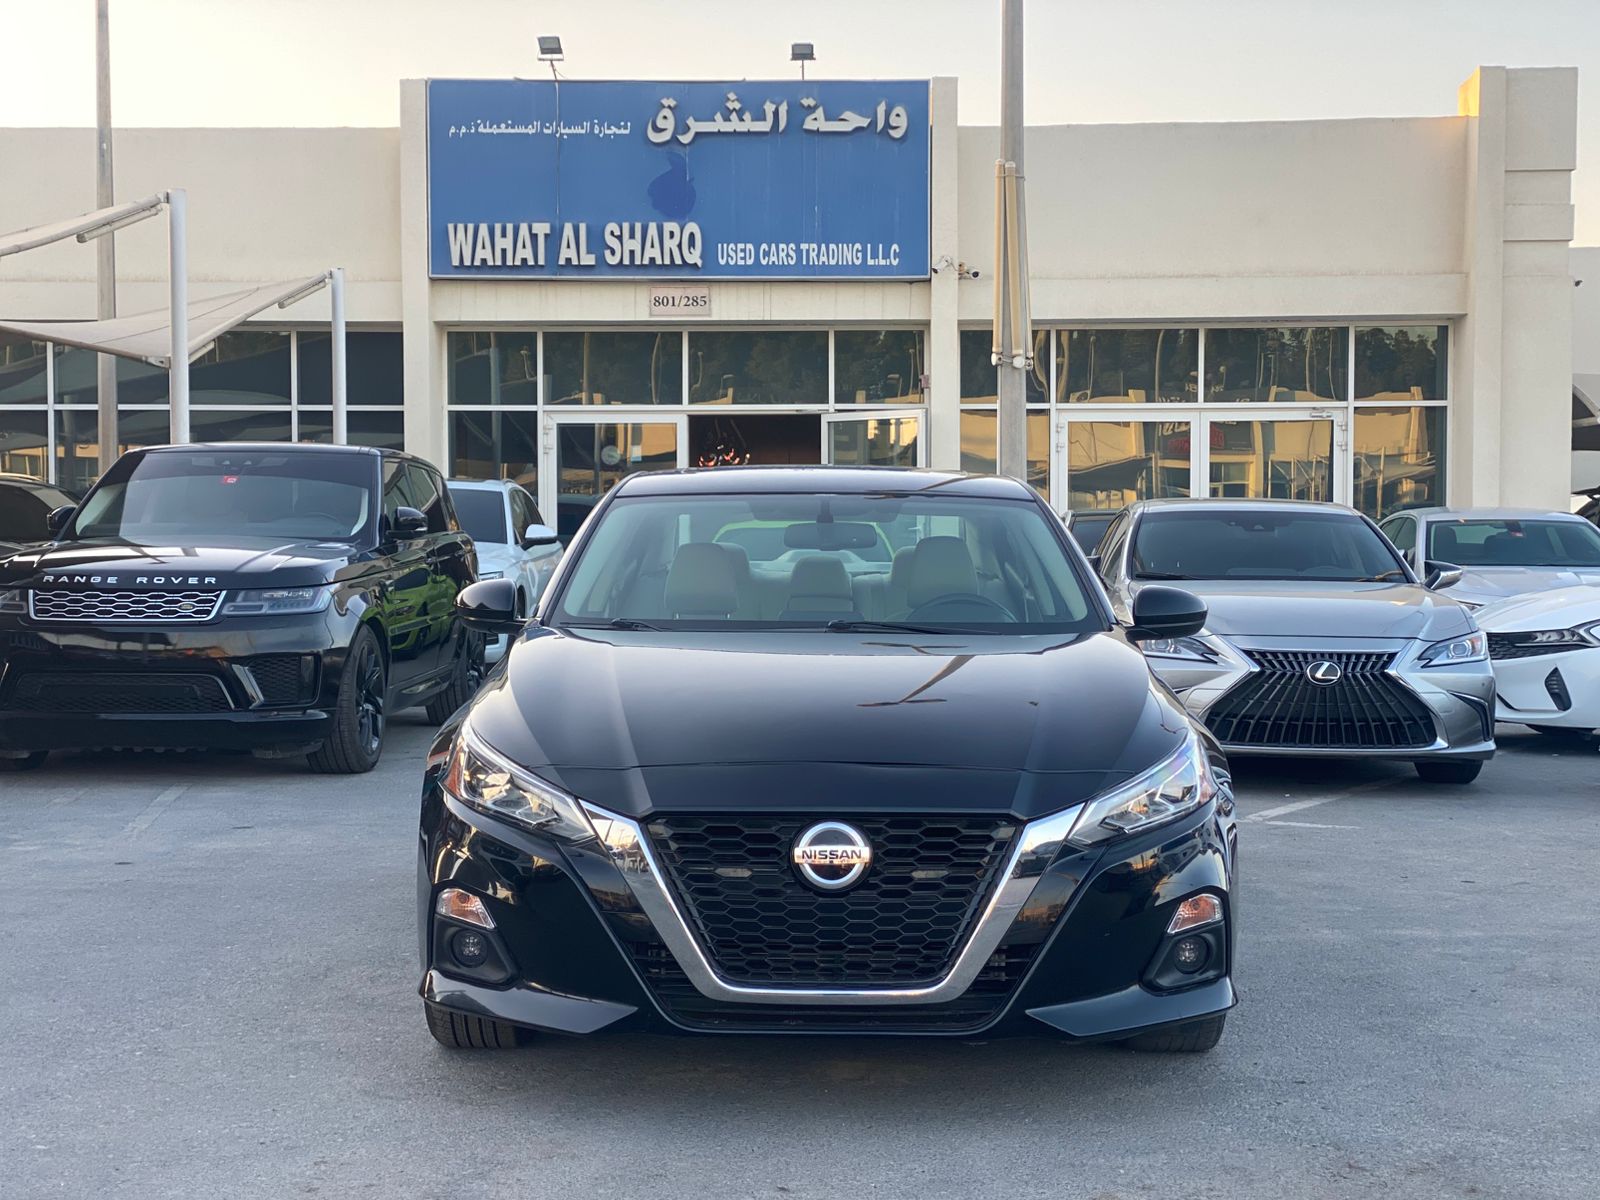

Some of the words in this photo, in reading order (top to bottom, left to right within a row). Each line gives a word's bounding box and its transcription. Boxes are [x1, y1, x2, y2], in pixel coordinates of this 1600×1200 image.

[477, 119, 541, 135] المستعملة
[646, 91, 788, 144] الشرق
[800, 97, 908, 139] واحة
[543, 119, 590, 139] السيارات
[593, 121, 631, 139] لتجارة
[447, 222, 551, 267] WAHAT
[557, 222, 596, 266] AL
[604, 221, 703, 268] SHARQ
[717, 243, 755, 266] USED
[759, 243, 797, 266] CARS
[800, 243, 863, 266] TRADING
[866, 243, 900, 266] L.L.C
[652, 295, 708, 308] 801/285
[42, 575, 119, 584] RANGE
[135, 576, 217, 585] ROVER
[801, 849, 862, 860] NISSAN
